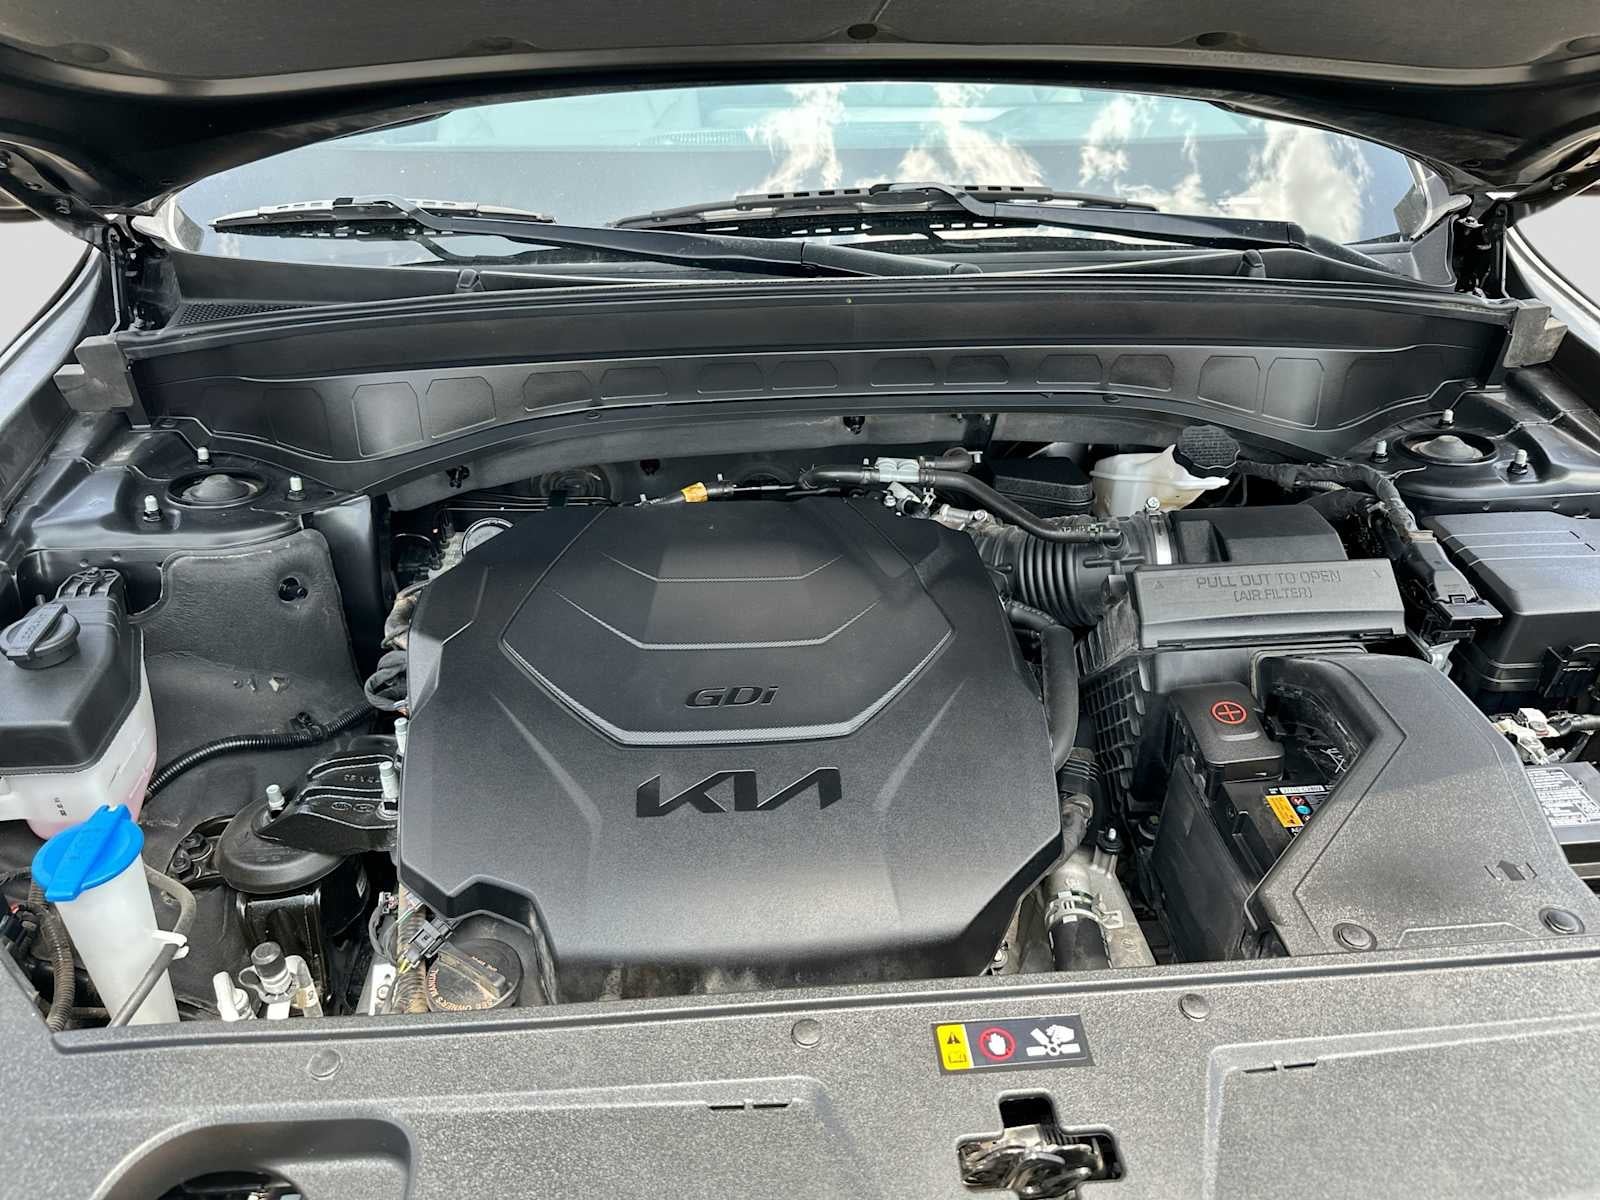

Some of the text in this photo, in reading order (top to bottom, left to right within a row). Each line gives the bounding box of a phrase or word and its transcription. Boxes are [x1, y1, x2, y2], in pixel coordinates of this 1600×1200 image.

[1196, 570, 1342, 588] PULL OUT TO OPEN
[636, 767, 842, 817] KIA
